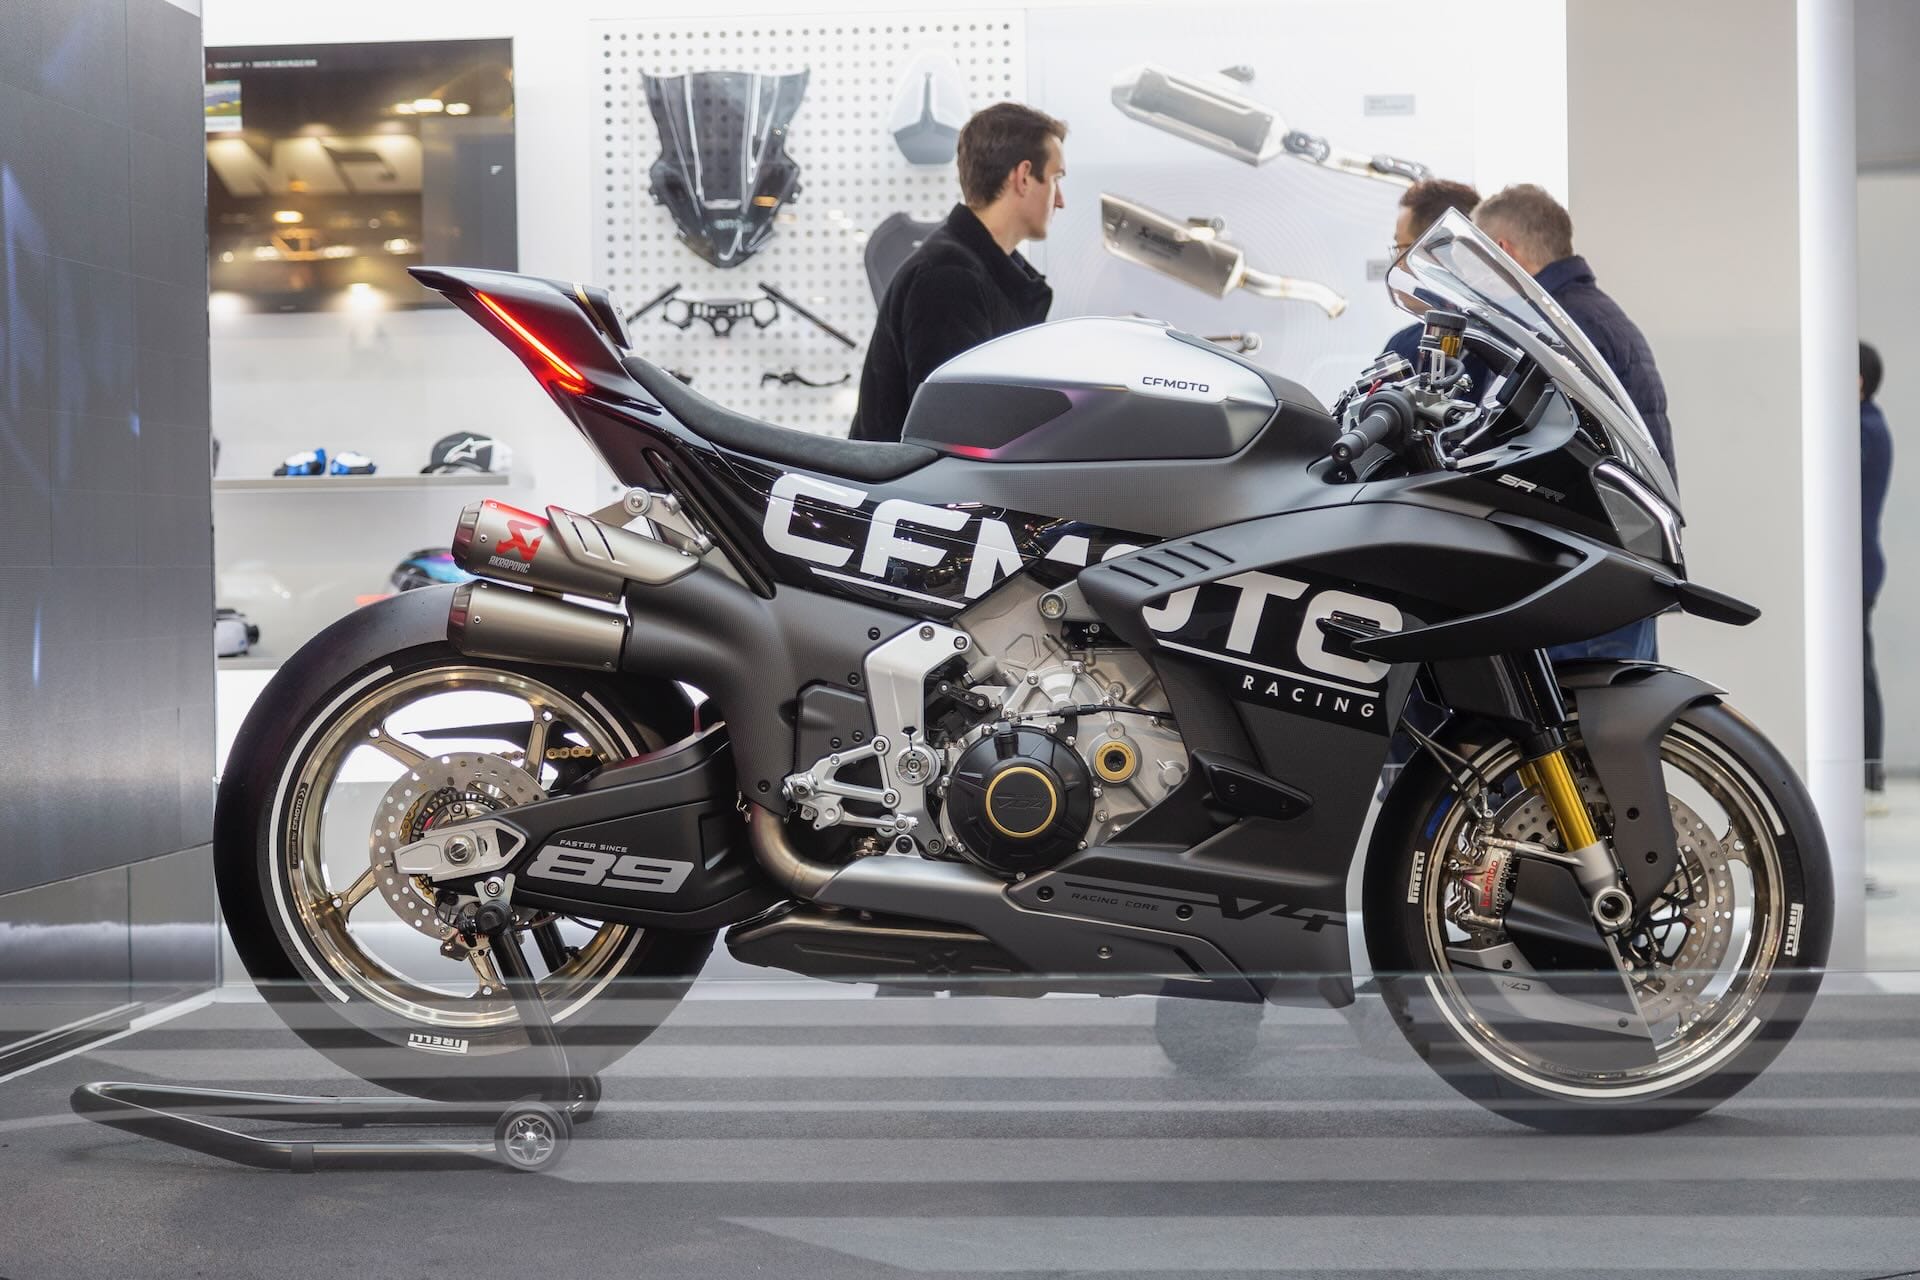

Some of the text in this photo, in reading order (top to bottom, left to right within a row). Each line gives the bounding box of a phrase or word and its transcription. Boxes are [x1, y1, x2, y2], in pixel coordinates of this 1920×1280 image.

[1142, 376, 1210, 393] CFMOTO
[1242, 674, 1375, 718] RACING
[292, 798, 303, 831] CFMOTO
[559, 839, 628, 853] FASTER SINCE
[526, 845, 695, 894] 89
[1407, 850, 1426, 904] PIRELLI
[1478, 860, 1499, 908] brembo
[1071, 893, 1160, 912] RACING CORE
[1217, 893, 1348, 933] V4
[1784, 902, 1804, 957] PIRELLI
[407, 1033, 469, 1054] PIRELLI
